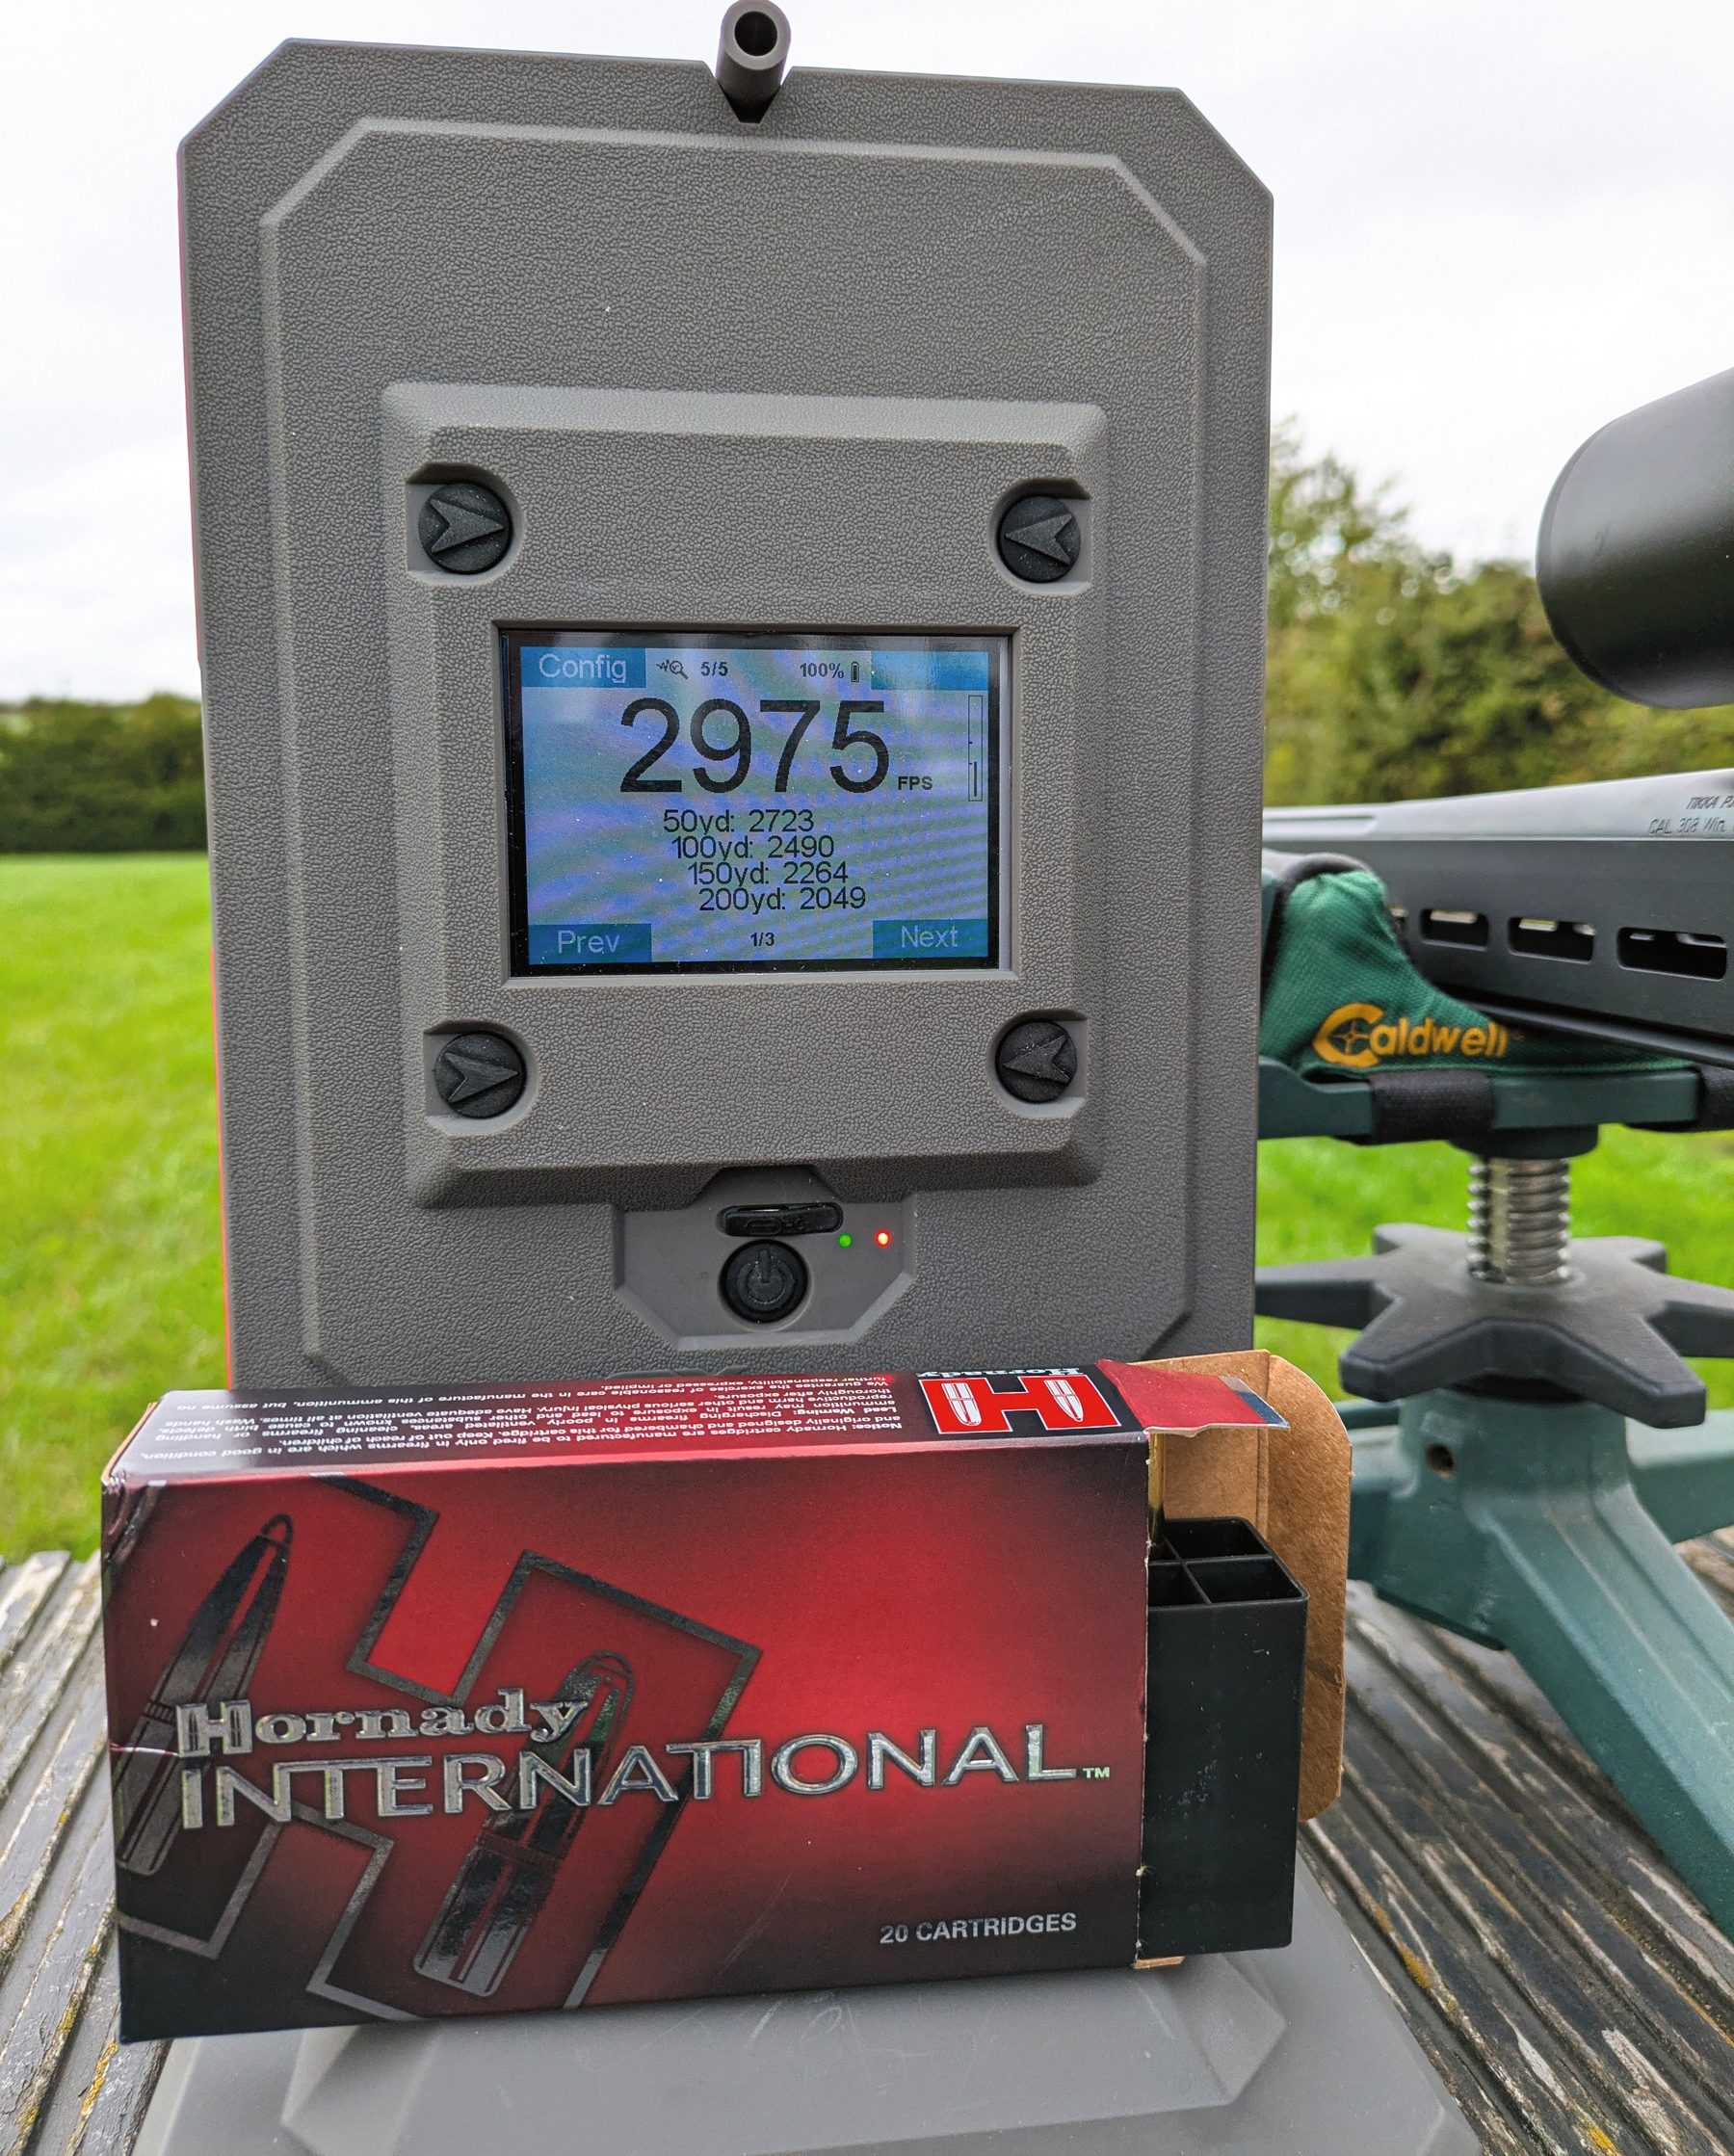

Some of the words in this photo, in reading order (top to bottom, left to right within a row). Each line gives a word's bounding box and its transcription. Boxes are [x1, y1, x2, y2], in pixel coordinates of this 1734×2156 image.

[539, 653, 627, 684] Config
[700, 661, 729, 677] 5/5
[800, 662, 845, 679] 100%
[619, 697, 890, 794] 2975
[897, 776, 933, 791] FPS
[663, 808, 736, 835] 50yd:
[749, 808, 815, 833] 2723
[671, 835, 754, 861] 100yd:
[767, 834, 835, 858] 2490
[688, 861, 770, 887] 150yd:
[783, 860, 849, 884] 2264
[698, 886, 786, 915] 200yd:
[799, 885, 867, 910] 2049
[557, 930, 620, 954] Prev
[749, 932, 775, 948] 1/3
[901, 926, 959, 949] Next
[1312, 1002, 1509, 1068] Caldwell
[917, 1367, 1084, 1379] Hornady
[675, 1380, 745, 1389] expressed
[794, 1380, 862, 1389] guarantee
[610, 1387, 686, 1396] reasonable
[816, 1387, 892, 1397] thoroughly
[386, 1396, 414, 1405] this
[437, 1392, 526, 1402] manufacture
[767, 1396, 804, 1406] harm
[806, 1393, 893, 1403] reproductive
[261, 1401, 288, 1409] but
[583, 1402, 641, 1412] physical
[643, 1401, 696, 1409] serious
[737, 1398, 764, 1407] and
[774, 1403, 805, 1411] may
[812, 1399, 896, 1408] ammunition
[425, 1407, 493, 1417] adequate
[632, 1407, 698, 1415] exposure
[726, 1404, 767, 1412] result
[792, 1407, 855, 1416] Warning:
[862, 1406, 898, 1414] Lead
[305, 1414, 326, 1423] all
[327, 1413, 344, 1422] at
[346, 1410, 423, 1421] ventilation
[488, 1413, 528, 1422] other
[535, 1411, 564, 1421] and
[570, 1410, 602, 1419] lead
[628, 1413, 689, 1422] firearms
[698, 1409, 782, 1420] Discharging
[874, 1414, 901, 1423] and
[318, 1420, 335, 1429] to
[338, 1418, 393, 1430] known
[400, 1415, 482, 1425] substances
[463, 1419, 537, 1430] ventilated
[545, 1416, 593, 1427] poorly
[737, 1418, 802, 1429] designed
[804, 1415, 872, 1426] originally
[267, 1421, 311, 1430] cause
[334, 1425, 399, 1434] cleaning
[623, 1422, 704, 1433] chambered
[706, 1421, 735, 1430] and
[785, 1424, 848, 1433] Hornady
[851, 1421, 903, 1431] Notice:
[261, 1428, 325, 1437] firearms
[456, 1431, 494, 1439] Keep
[568, 1427, 597, 1435] this
[681, 1429, 706, 1437] are
[709, 1426, 782, 1436] cartridges
[340, 1435, 362, 1445] of
[364, 1434, 407, 1444] reach
[407, 1433, 426, 1442] of
[427, 1432, 454, 1441] out
[491, 1436, 528, 1446] fired
[531, 1435, 551, 1444] be
[575, 1431, 677, 1442] manufactured
[367, 1440, 431, 1450] firearms
[434, 1439, 451, 1448] in
[454, 1437, 488, 1447] only
[267, 1446, 283, 1456] in
[286, 1445, 313, 1454] are
[317, 1443, 363, 1454] which
[174, 1687, 589, 1758] Hornady
[181, 1723, 1077, 1829] INTERNATIONAL
[879, 1924, 909, 1945] 20
[915, 1911, 1077, 1943] CARTRIDGES
